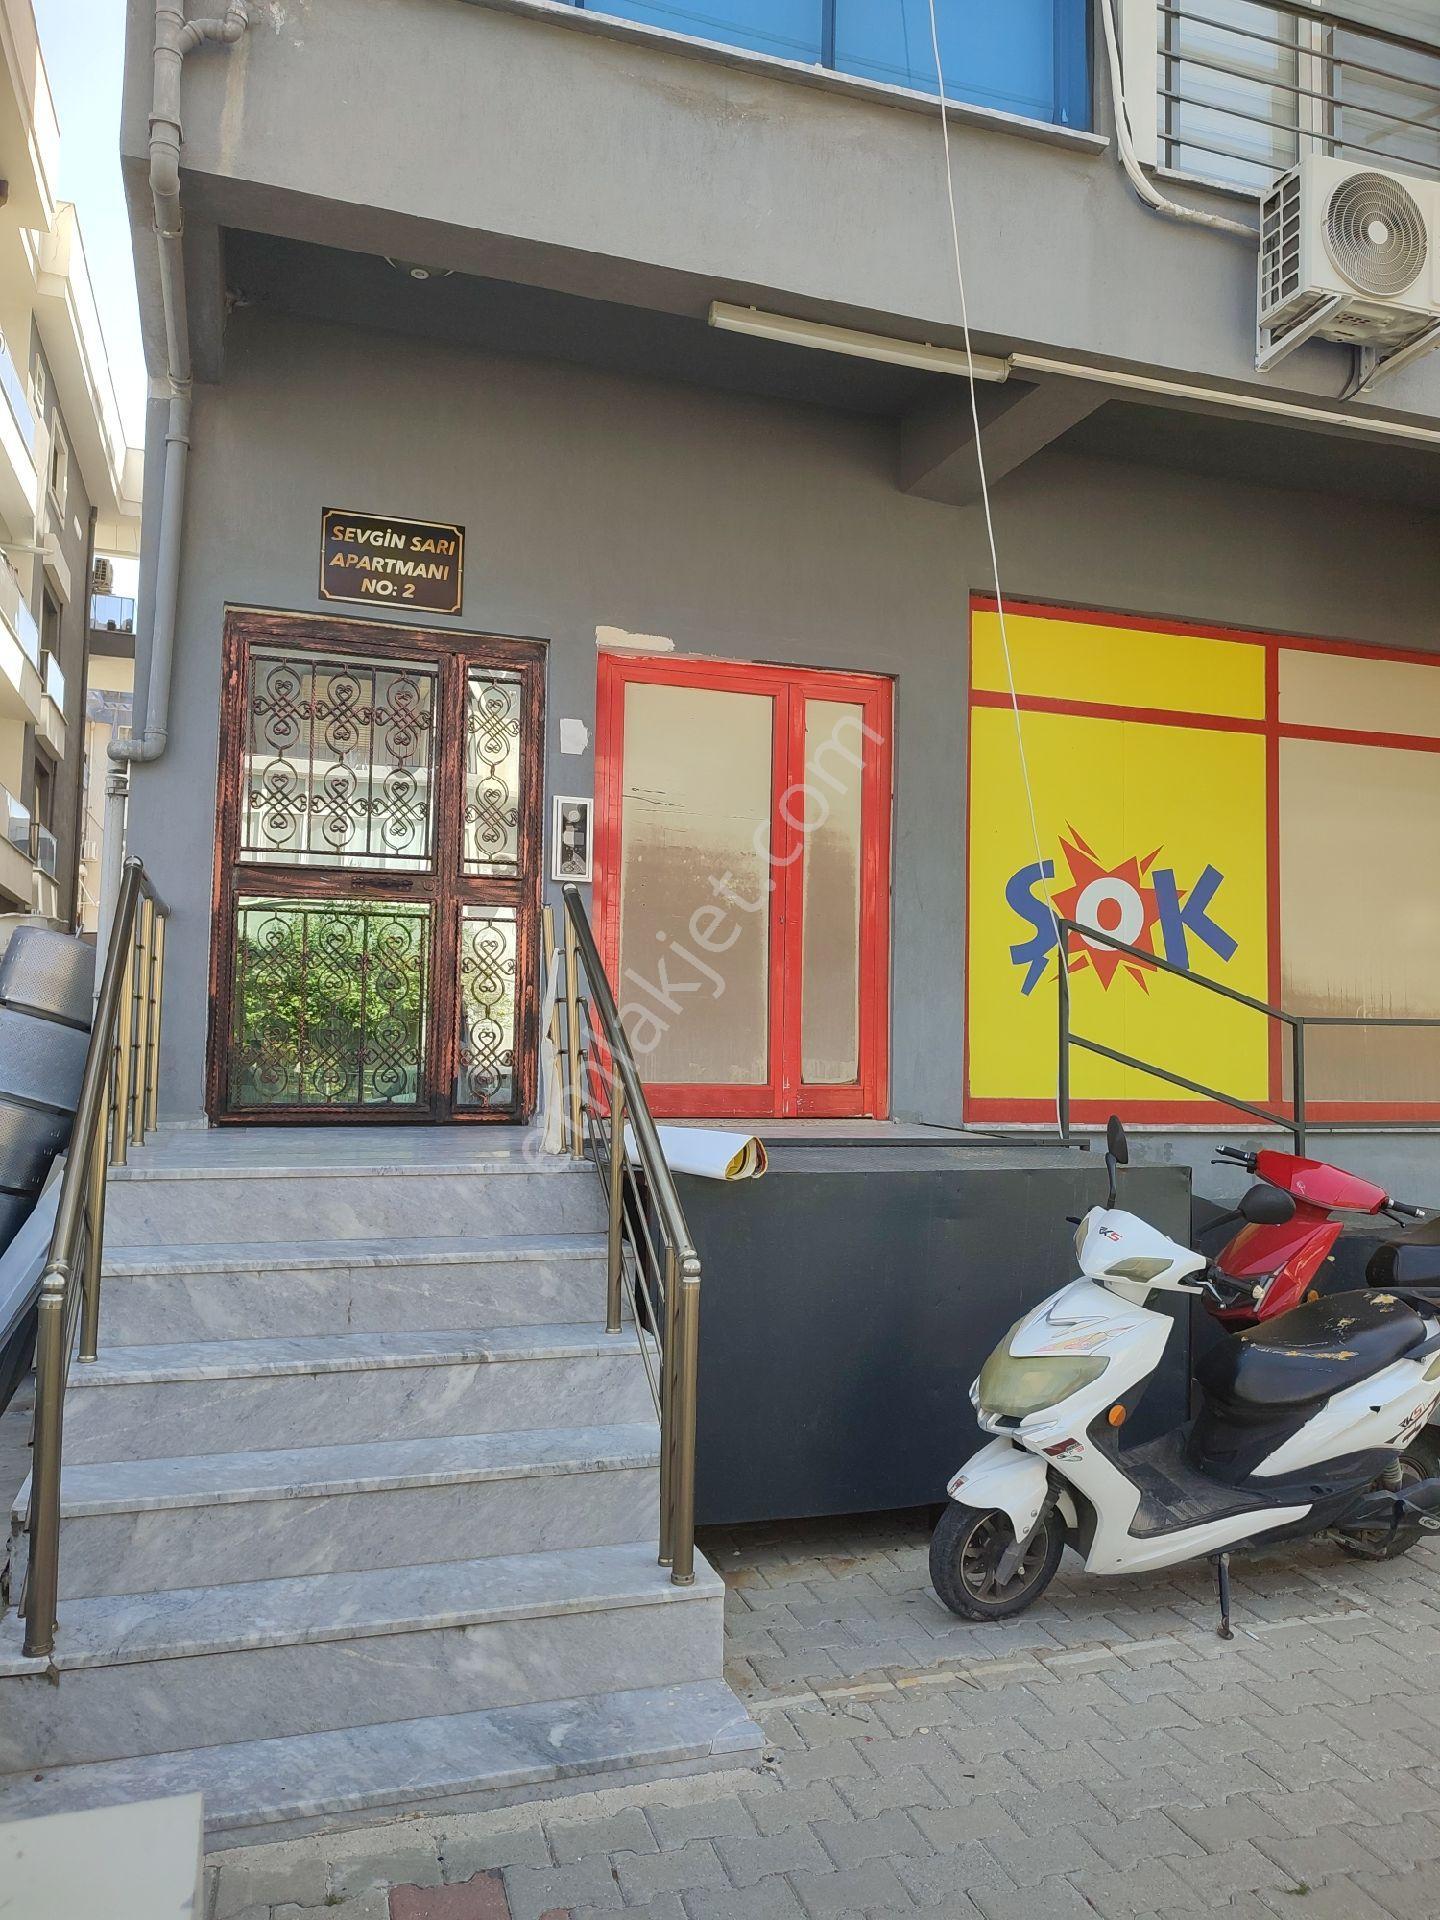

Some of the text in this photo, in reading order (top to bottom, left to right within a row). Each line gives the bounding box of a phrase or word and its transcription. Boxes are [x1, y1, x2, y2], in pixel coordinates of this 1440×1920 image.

[331, 525, 456, 556] SEVGİN SARI
[329, 552, 449, 581] APARTMANI
[361, 577, 416, 599] NO: 2
[1005, 859, 1239, 997] ŞOK
